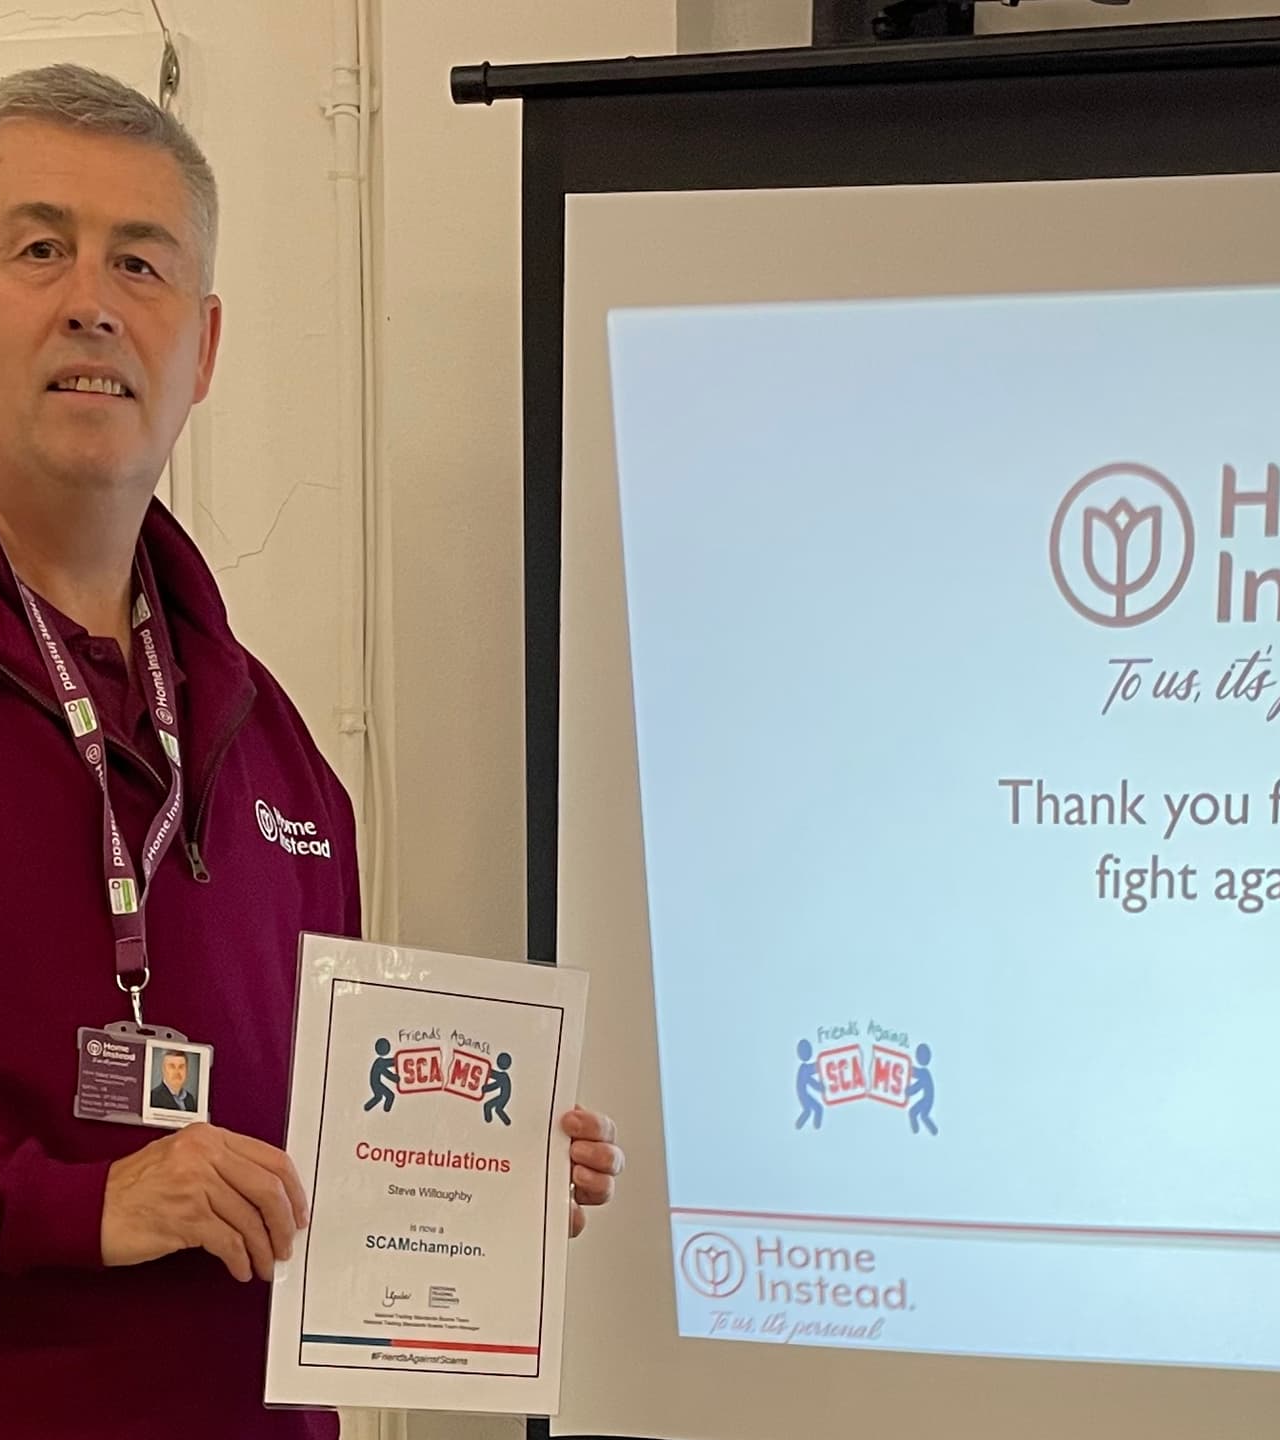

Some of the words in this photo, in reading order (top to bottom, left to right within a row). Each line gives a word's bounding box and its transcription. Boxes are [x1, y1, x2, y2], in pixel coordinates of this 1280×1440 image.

[139, 628, 160, 671] Instead
[152, 671, 168, 707] Home
[1102, 658, 1153, 715] To
[1152, 669, 1201, 703] us,
[1216, 644, 1277, 701] it's
[998, 779, 1147, 826] Thank
[1163, 793, 1250, 840] you
[147, 820, 170, 861] Home
[1096, 853, 1198, 913] fight
[399, 1027, 441, 1042] Friends
[450, 1030, 491, 1055] Against
[817, 1021, 860, 1043] Friends
[867, 1020, 910, 1048] Against
[356, 1142, 511, 1173] Congratulations
[388, 1184, 416, 1197] Steve
[419, 1187, 472, 1203] Willoughby
[366, 1235, 486, 1257] SCAMchampion.
[755, 1235, 876, 1273] Home
[708, 1310, 730, 1335] To
[785, 1318, 886, 1344] personal
